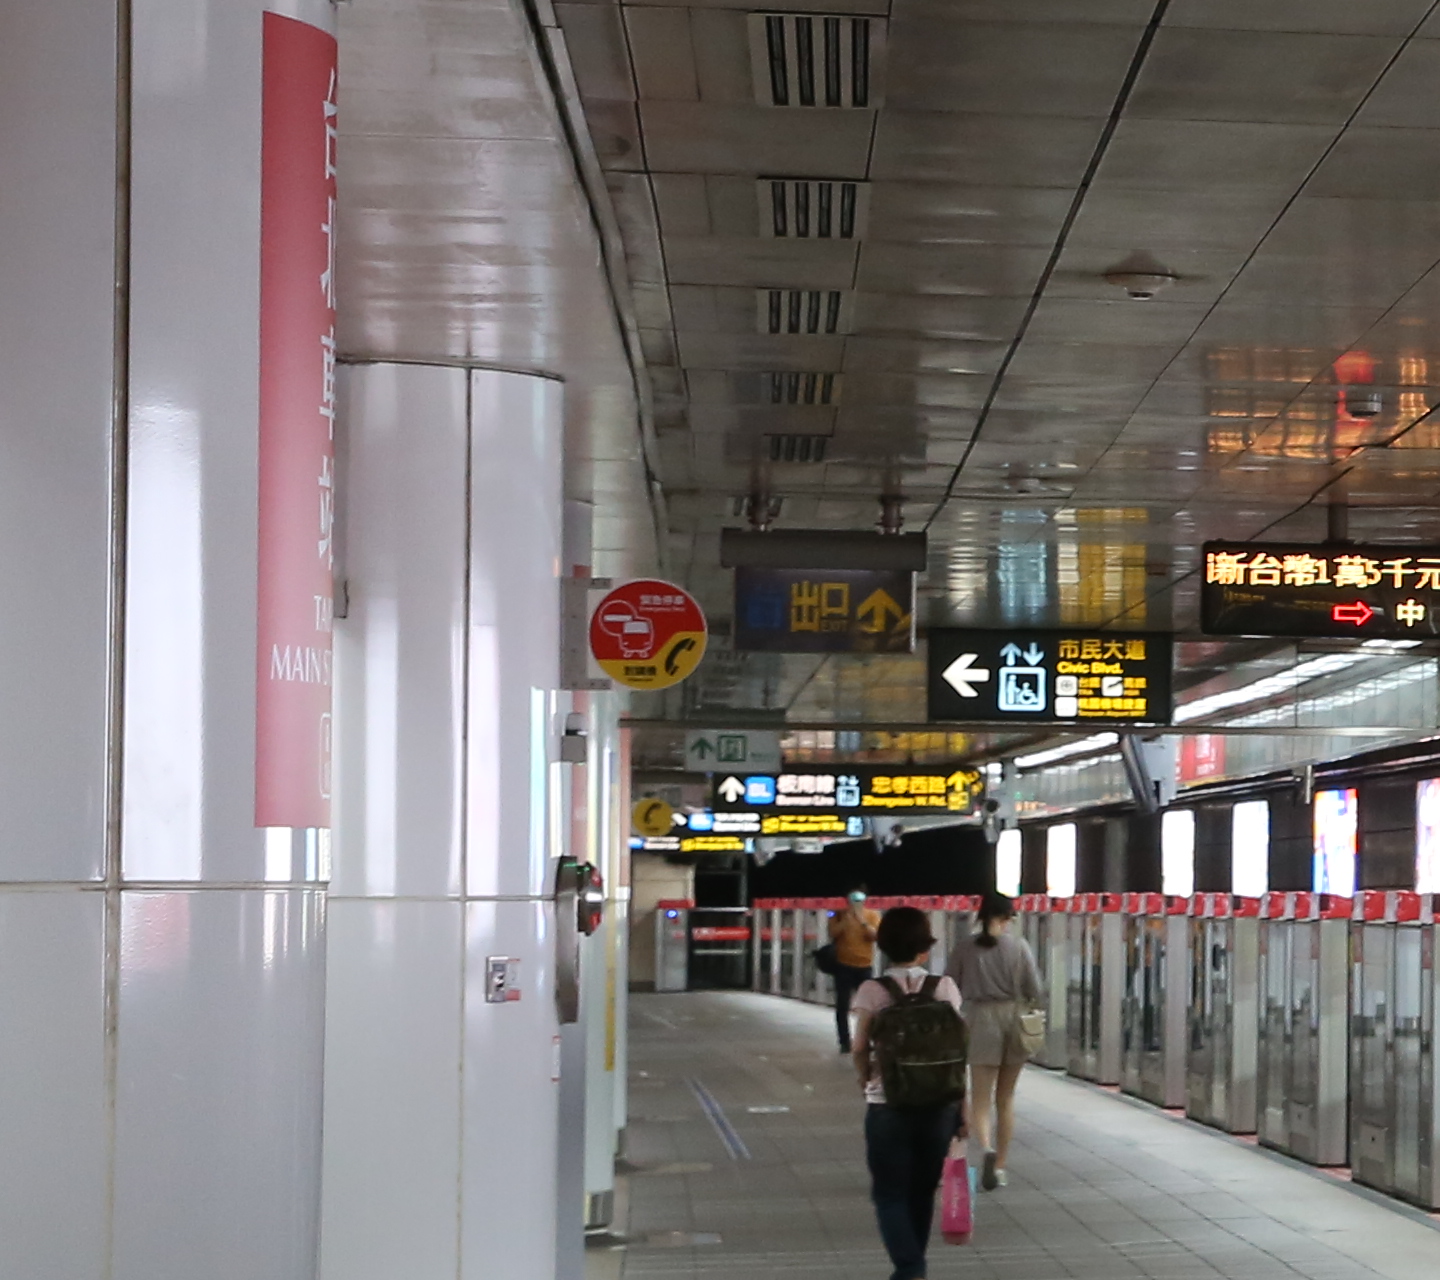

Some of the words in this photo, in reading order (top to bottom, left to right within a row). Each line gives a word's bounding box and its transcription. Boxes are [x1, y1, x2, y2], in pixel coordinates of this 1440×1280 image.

[791, 580, 849, 632] 出口
[271, 644, 320, 684] MAIN
[1059, 639, 1146, 660] 市民大道
[1057, 661, 1090, 674] Civic
[1091, 662, 1124, 674] Blvd.
